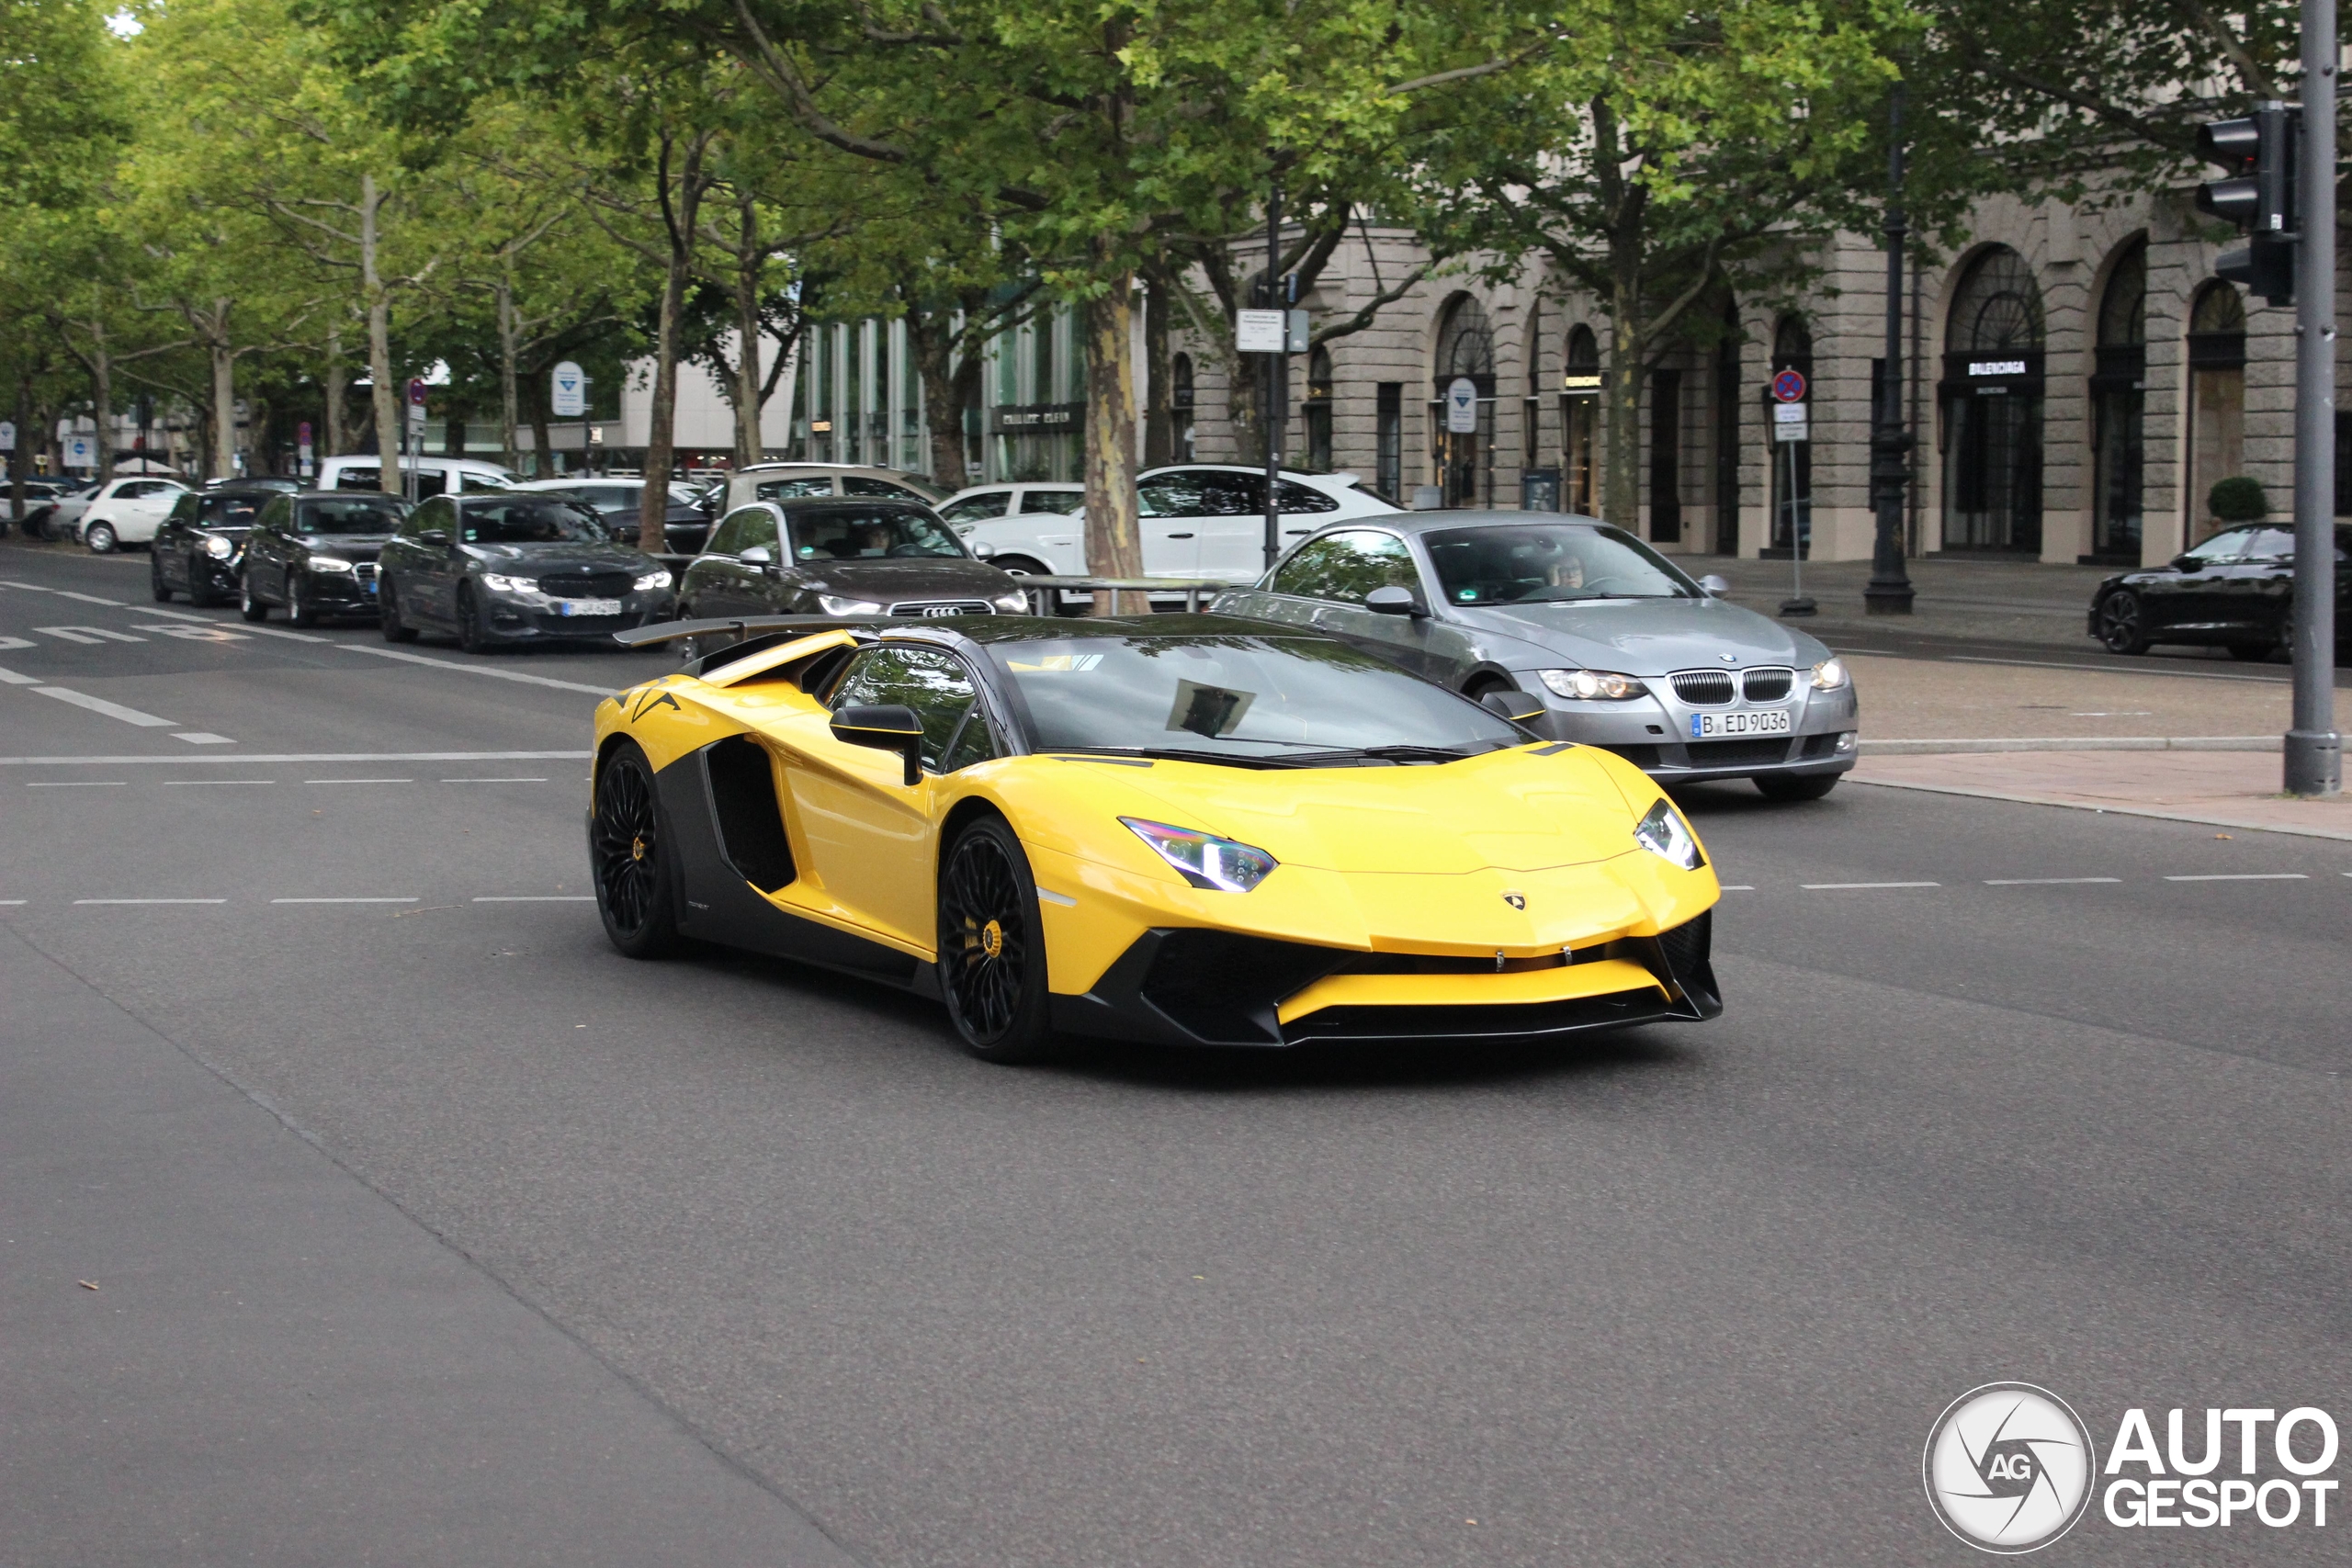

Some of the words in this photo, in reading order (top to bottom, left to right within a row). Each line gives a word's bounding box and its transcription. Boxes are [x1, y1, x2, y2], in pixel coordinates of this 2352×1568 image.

[1702, 716, 1713, 734] B
[1725, 715, 1747, 733] ED
[1749, 712, 1788, 731] 9036
